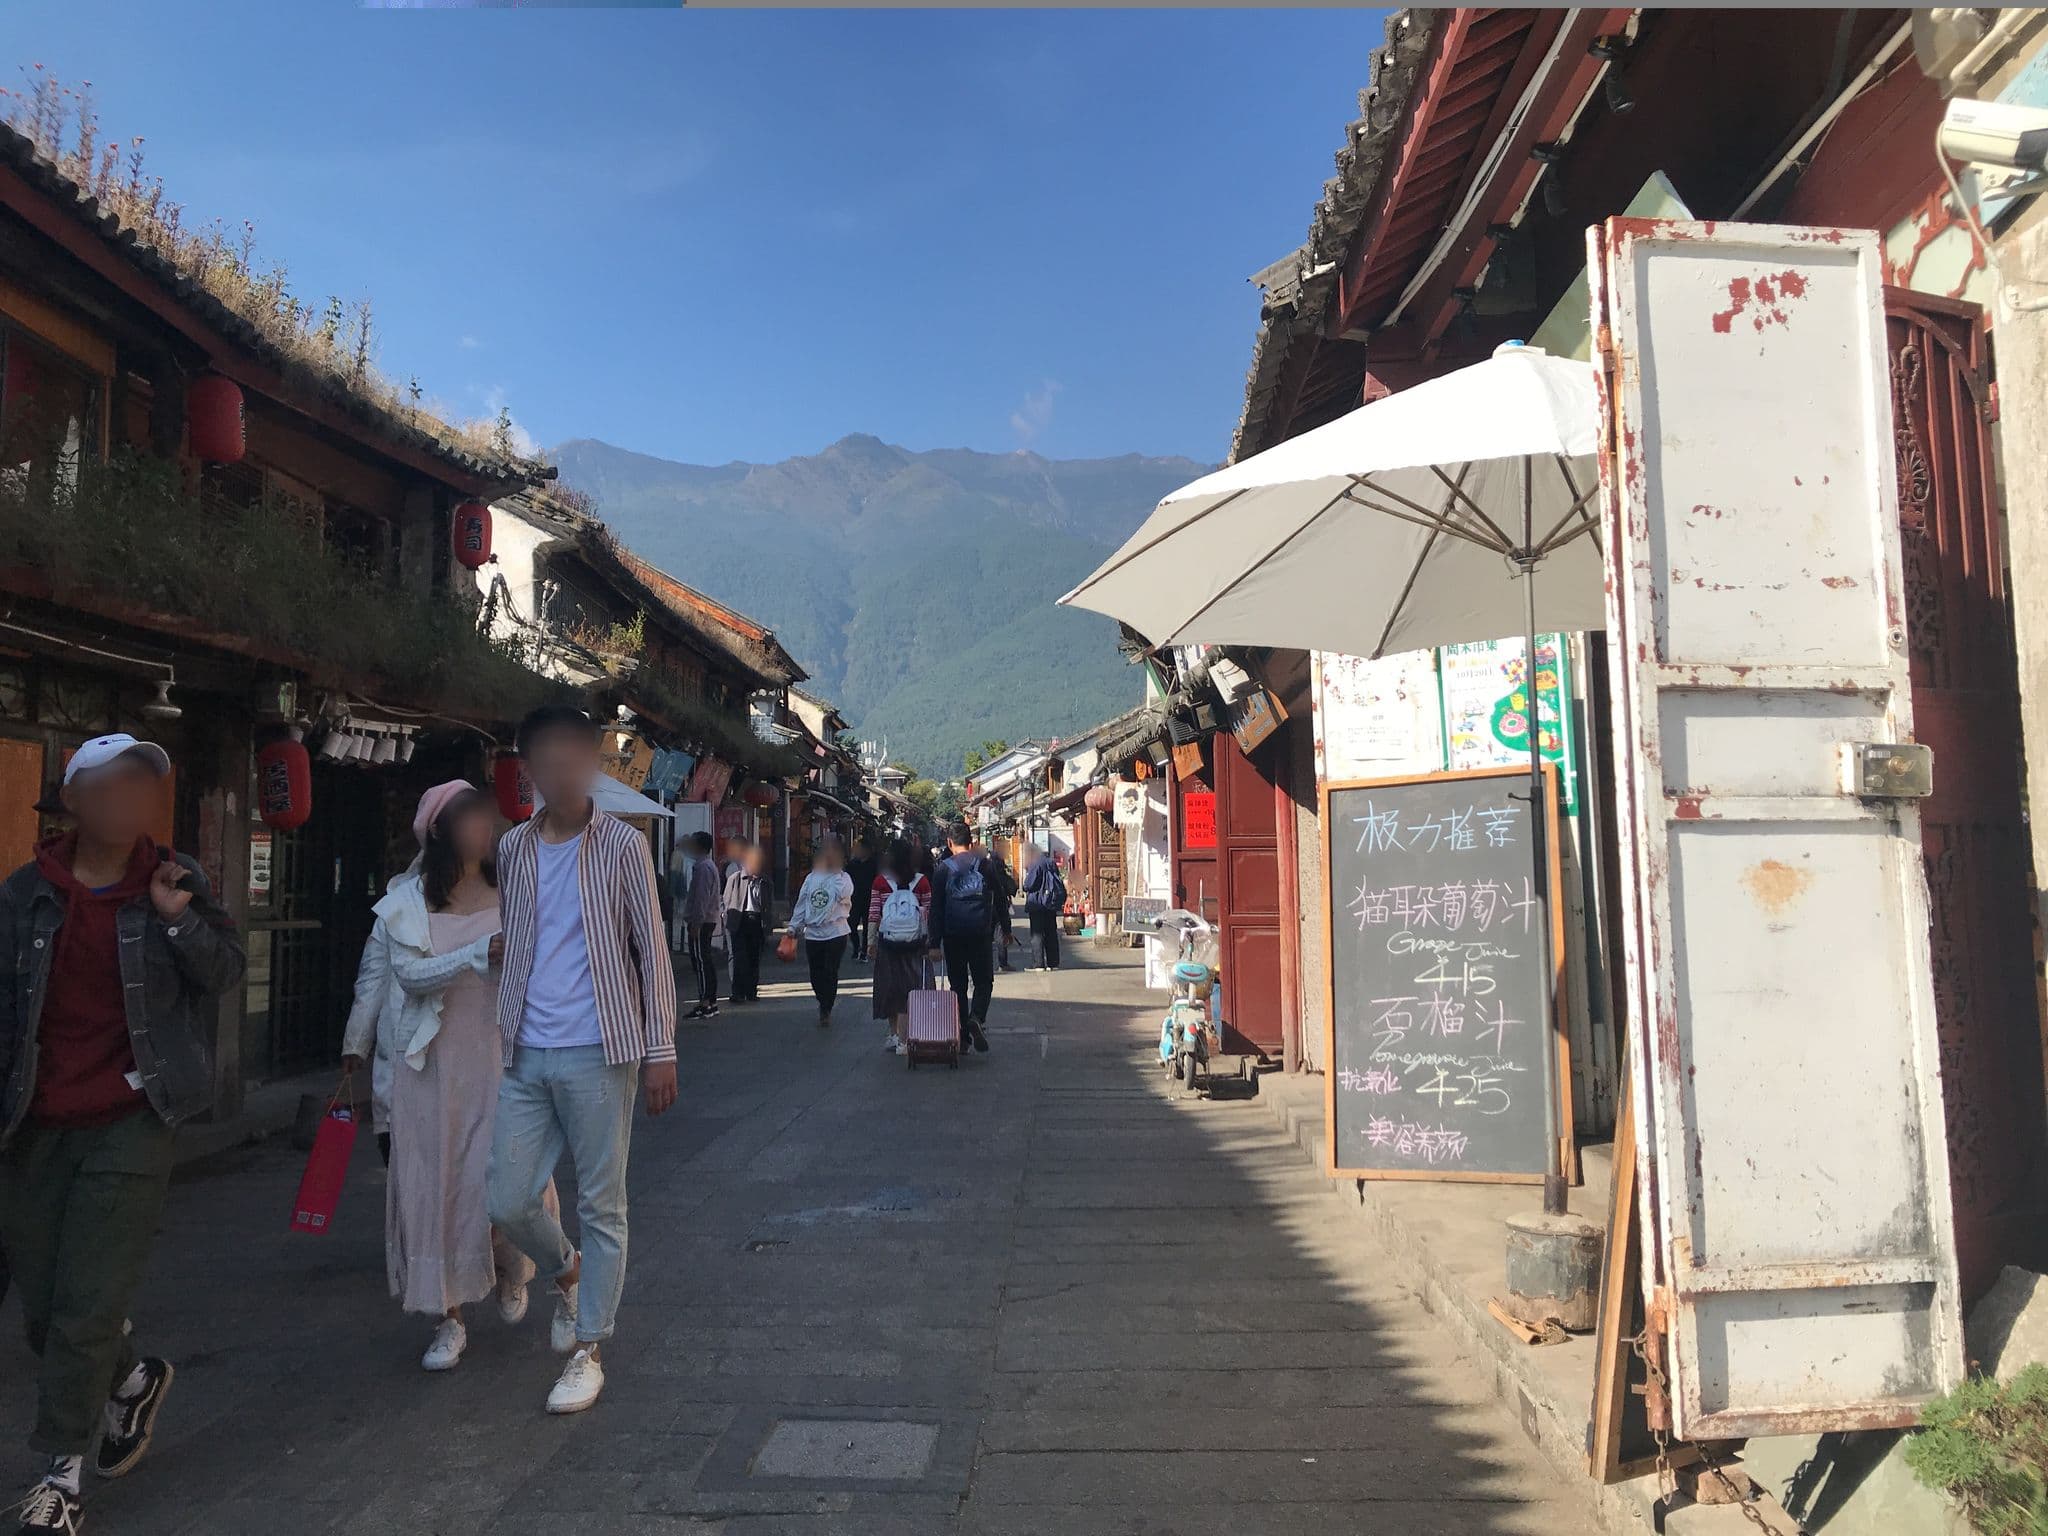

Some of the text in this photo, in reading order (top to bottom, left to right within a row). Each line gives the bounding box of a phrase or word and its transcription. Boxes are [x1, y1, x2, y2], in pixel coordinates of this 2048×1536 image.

[1352, 800, 1521, 855] 极力推荐
[1346, 874, 1537, 934] 猫耳朵葡萄汁
[1369, 991, 1526, 1055] 石榴汁
[1336, 1063, 1403, 1095] 抗氧化
[1360, 1113, 1470, 1165] 美容养颜
